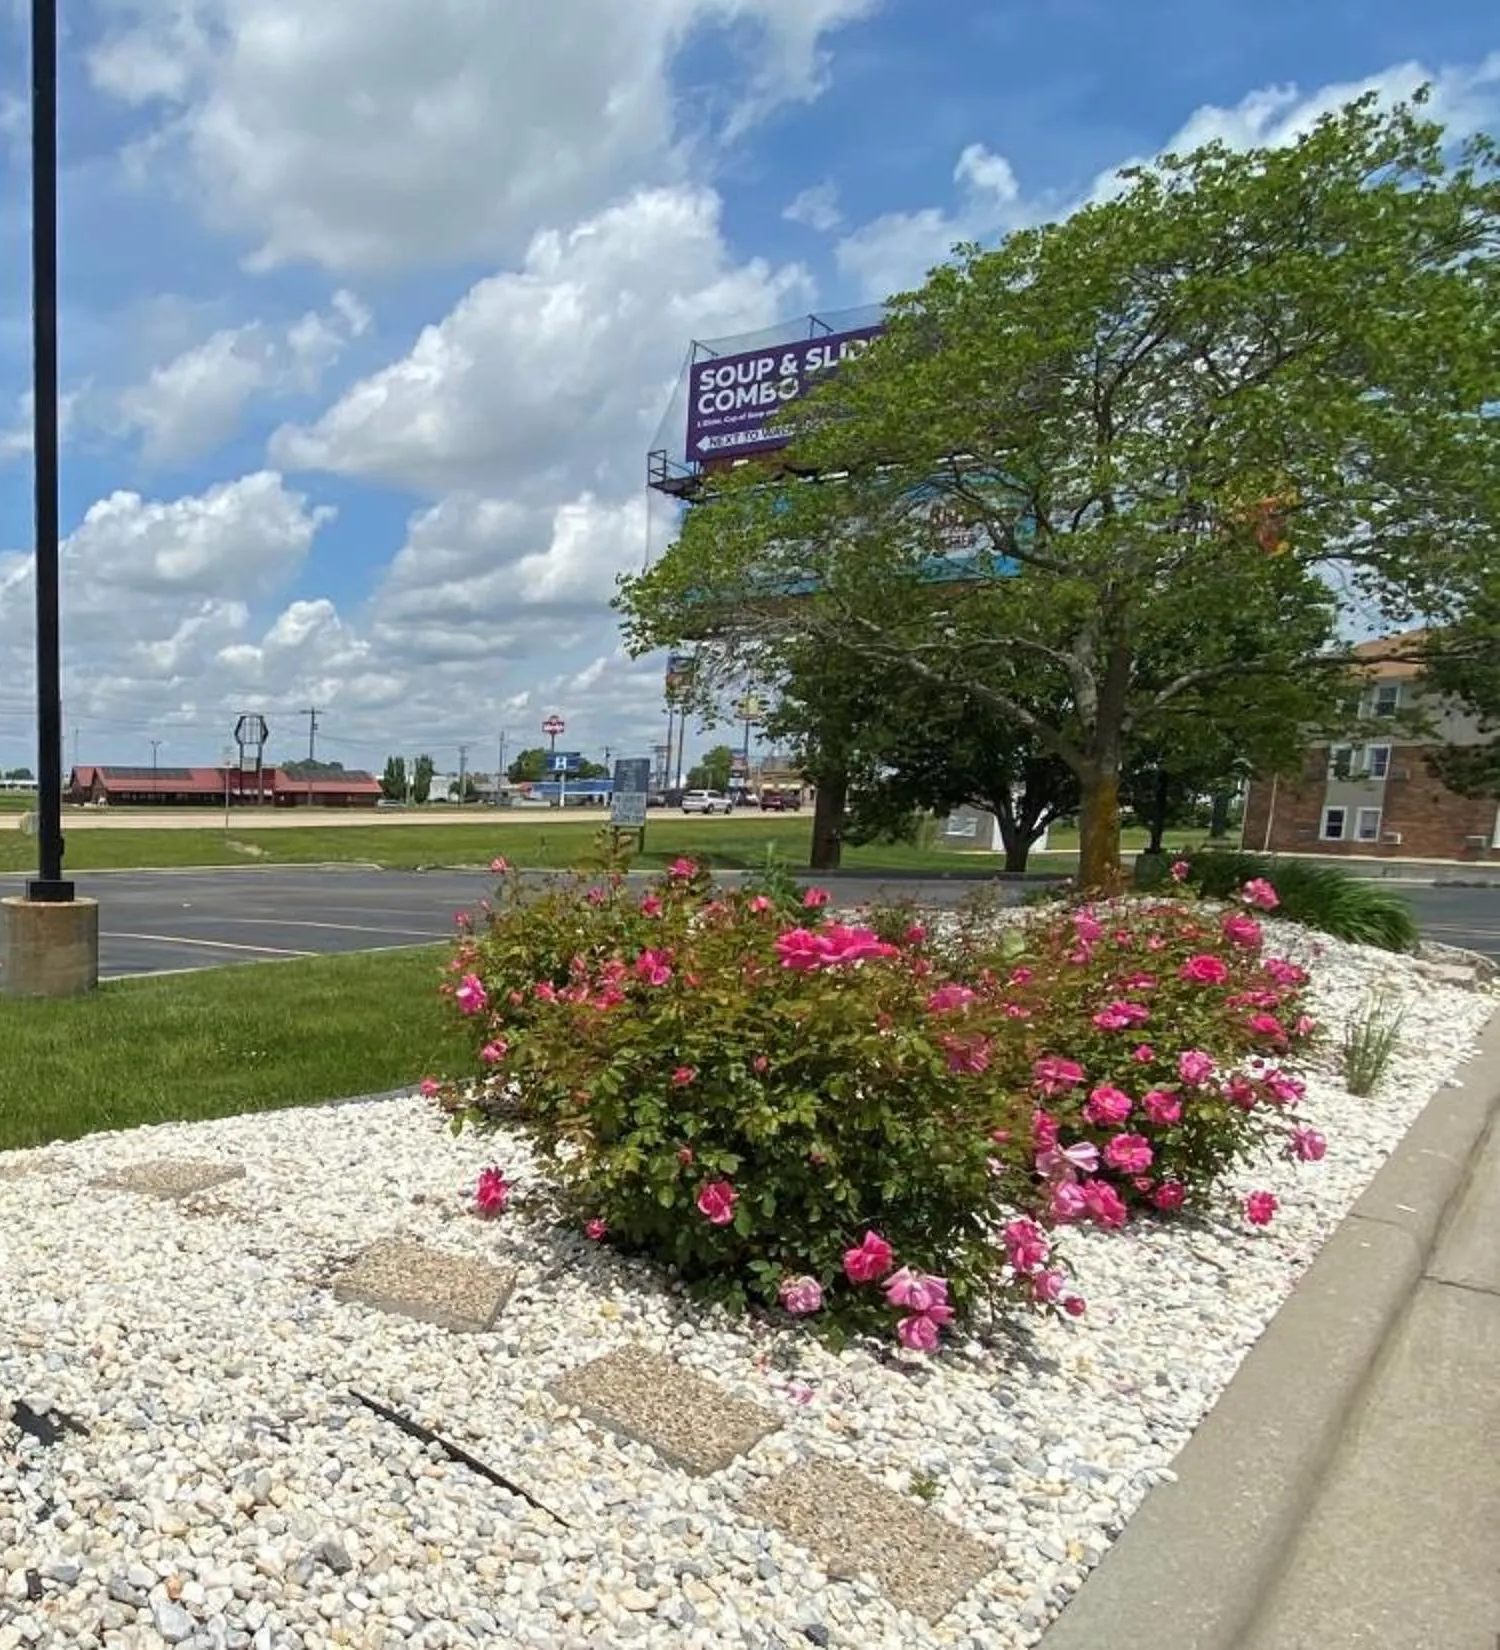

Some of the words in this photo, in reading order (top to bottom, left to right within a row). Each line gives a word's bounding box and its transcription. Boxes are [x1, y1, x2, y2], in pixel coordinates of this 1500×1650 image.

[700, 358, 775, 391] SOUP
[779, 353, 799, 376] &
[804, 336, 883, 371] SLID
[698, 378, 799, 414] COMBO
[710, 433, 742, 448] NEXT
[744, 430, 760, 443] TO
